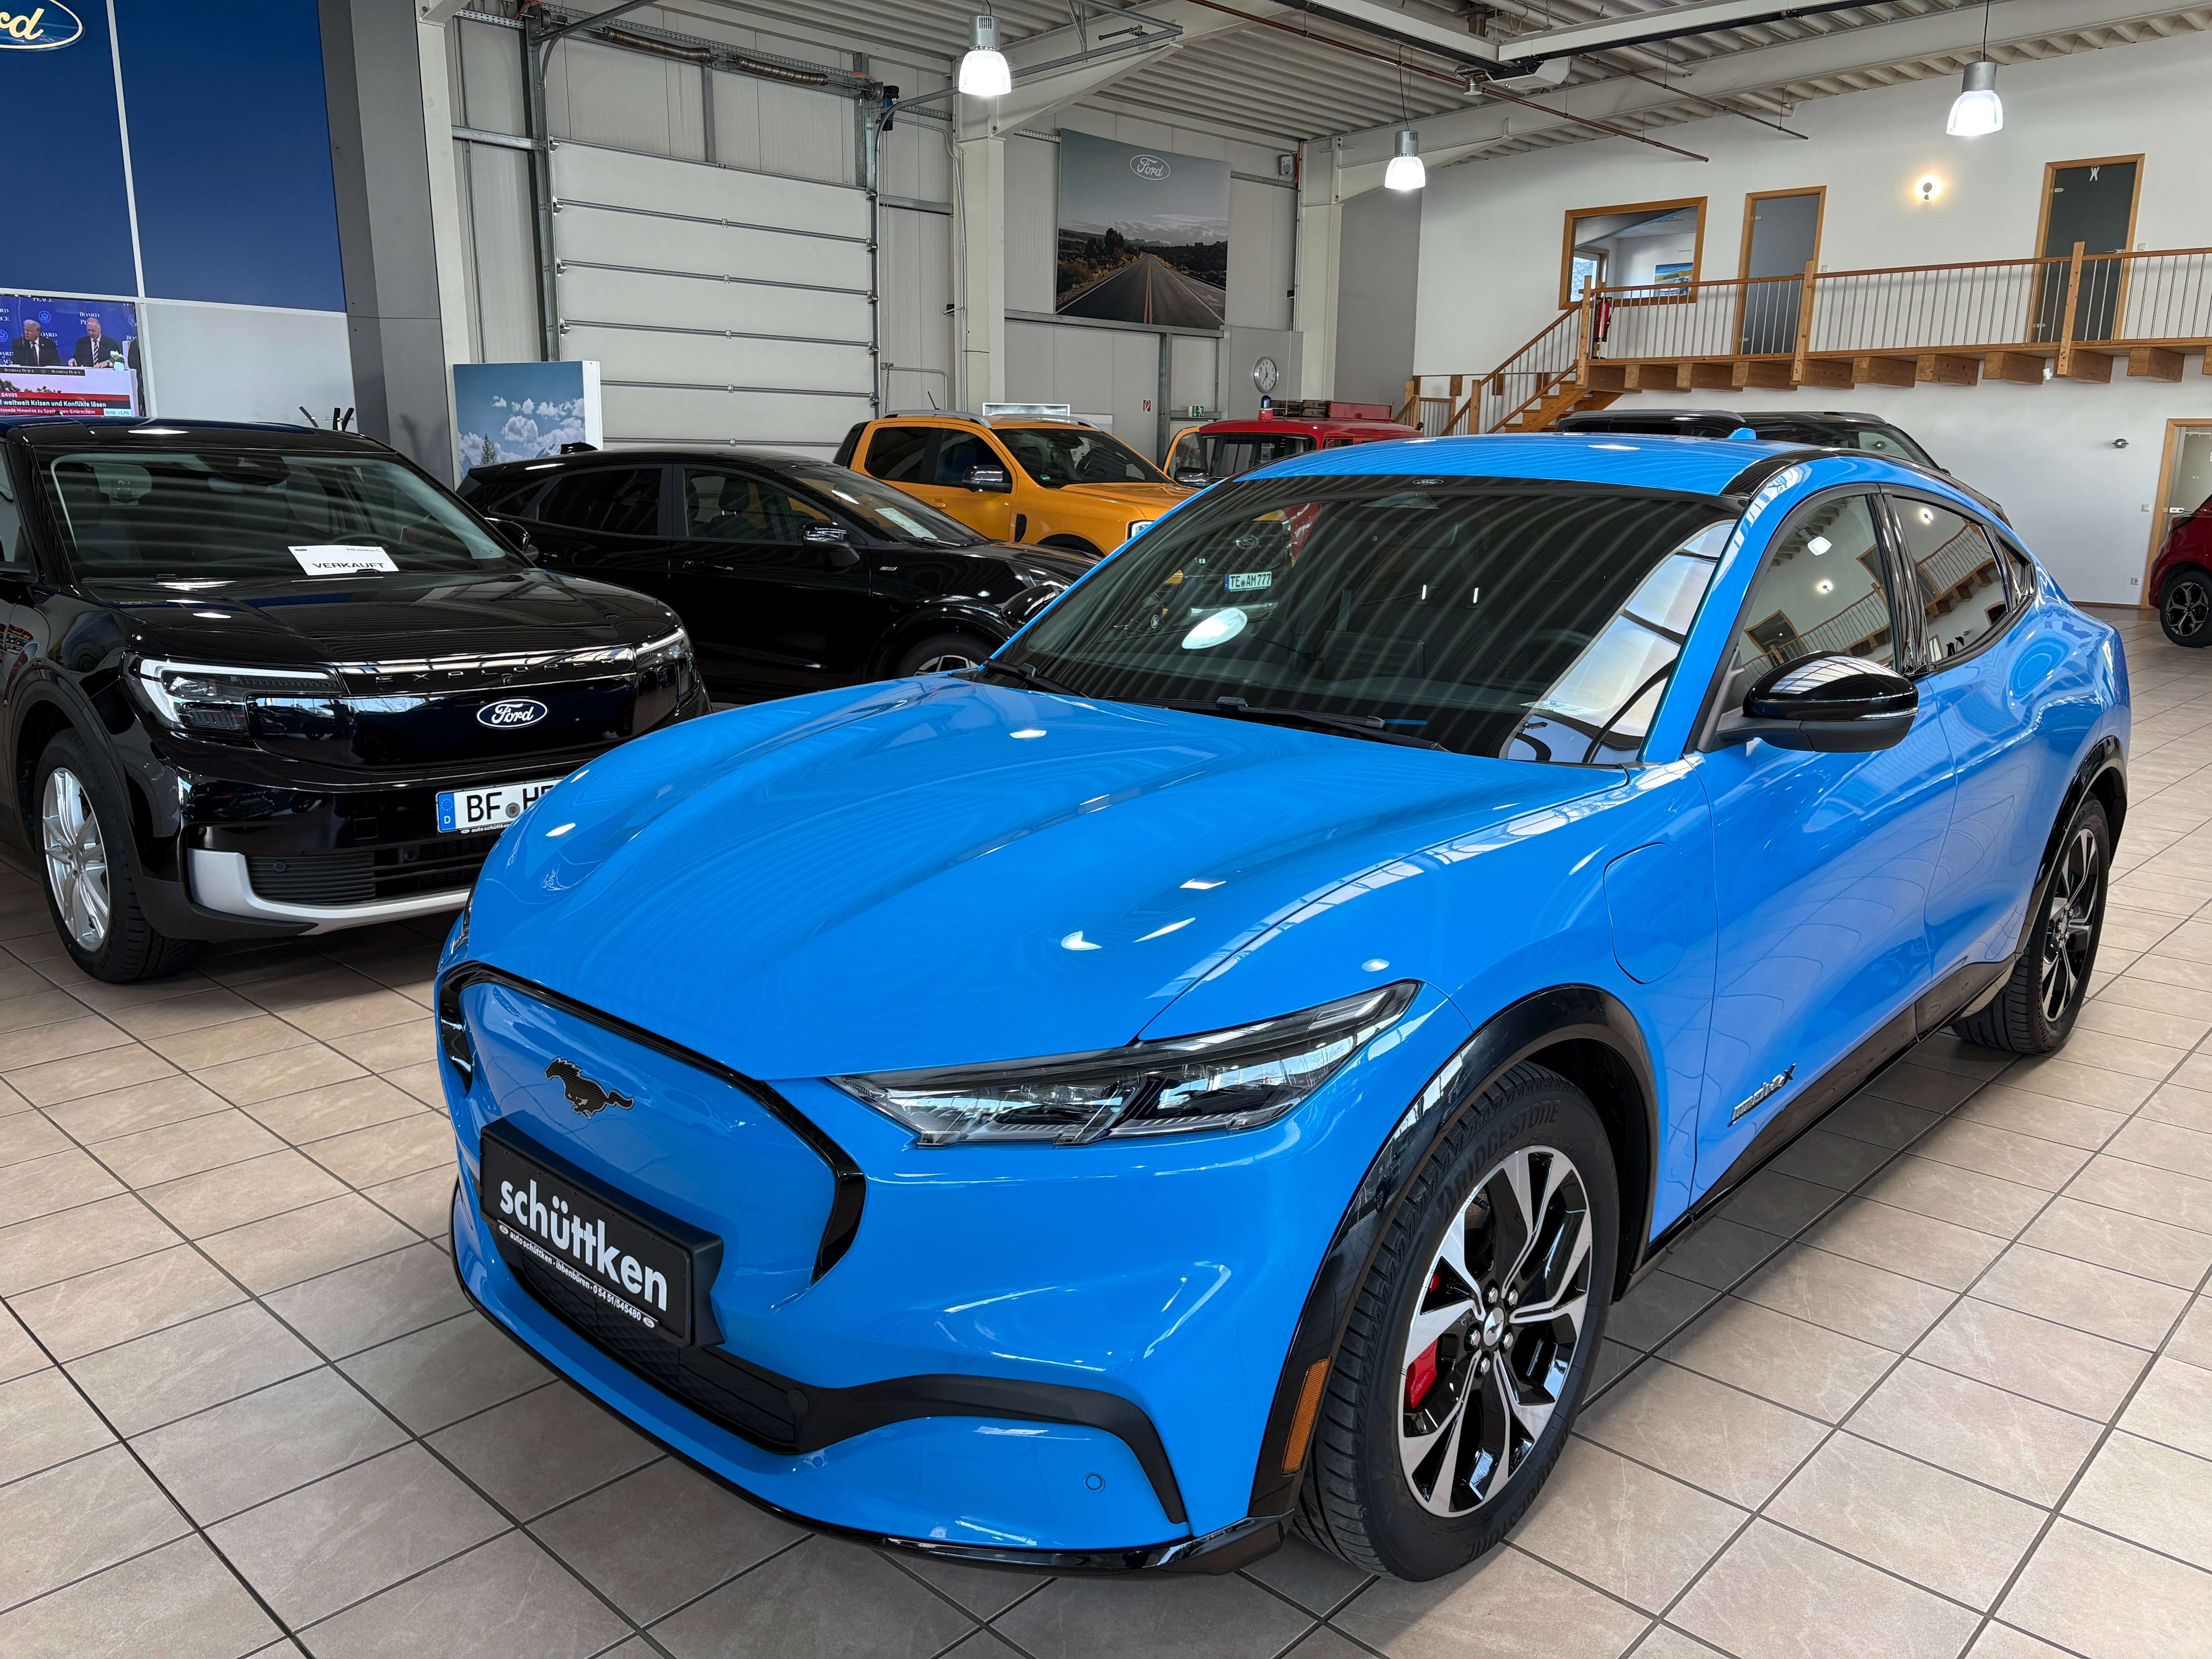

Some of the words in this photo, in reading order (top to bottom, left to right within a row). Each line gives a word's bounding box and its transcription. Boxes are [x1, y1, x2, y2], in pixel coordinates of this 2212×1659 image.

[0, 8, 45, 40] rd
[1137, 157, 1163, 177] Ford
[1230, 576, 1241, 588] TE
[1246, 575, 1256, 587] AM
[1257, 574, 1271, 586] 777
[375, 659, 615, 683] EXPLORER
[491, 703, 534, 724] Ford
[467, 792, 502, 823] BF
[522, 785, 555, 809] H
[444, 816, 451, 824] D
[1436, 1099, 1561, 1222] BRIDGESTONE
[500, 1179, 667, 1311] schüttken
[510, 1232, 522, 1245] auto
[523, 1242, 552, 1264] schüttken
[556, 1260, 590, 1289] ibbenbüren
[593, 1285, 597, 1294] 0
[598, 1288, 606, 1300] 54
[607, 1294, 641, 1321] 51/545480
